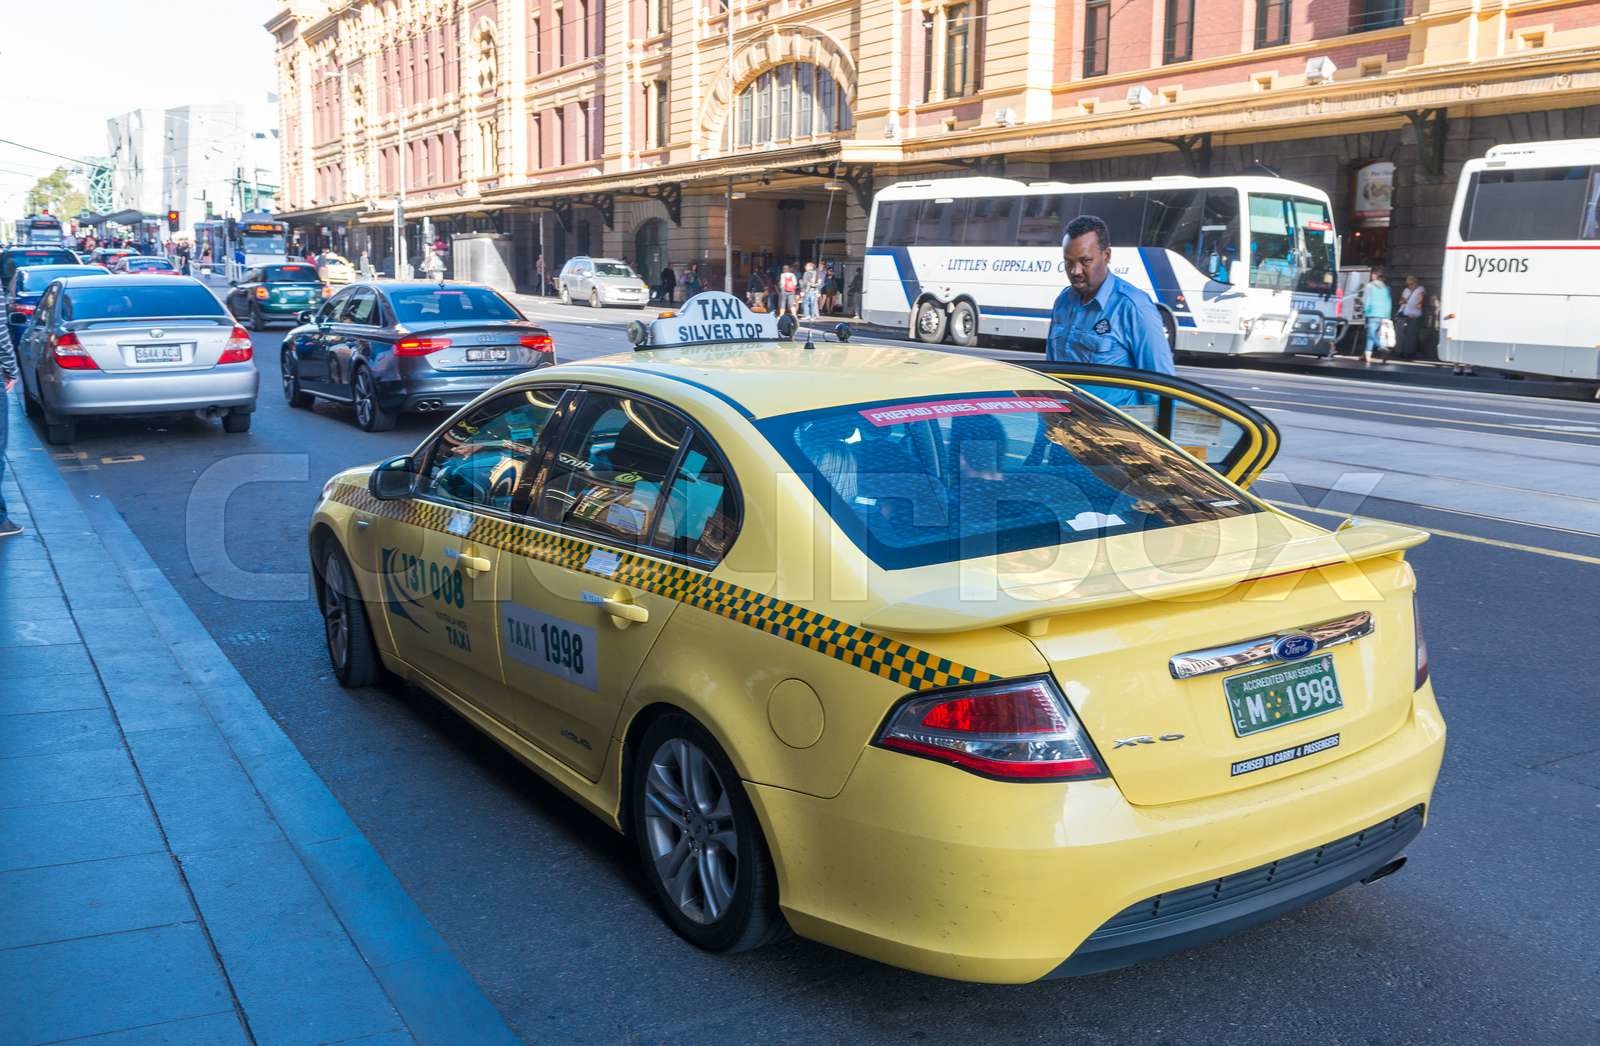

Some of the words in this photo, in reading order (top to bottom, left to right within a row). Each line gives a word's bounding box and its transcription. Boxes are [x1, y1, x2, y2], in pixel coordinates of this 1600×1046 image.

[947, 258, 988, 271] LITTLE'S
[992, 259, 1052, 272] GIPPSLAND
[1464, 253, 1529, 277] Dysons
[696, 298, 743, 320] TAXI
[678, 323, 732, 341] SILVER
[735, 323, 763, 339] TOP
[872, 408, 931, 422] PREPAID
[931, 404, 977, 414] FARES
[978, 402, 1013, 410] 10PM
[401, 553, 426, 592] 131
[430, 562, 465, 608] 008
[446, 625, 472, 653] TAXI
[507, 617, 537, 652] TAXI
[541, 623, 584, 674] 1998
[1284, 639, 1308, 656] Ford
[1243, 674, 1285, 692] ACCREDITED
[1297, 663, 1323, 679] SERVICE
[1232, 698, 1247, 728] VIC
[1246, 694, 1268, 725] M
[1286, 675, 1337, 714] 1998
[1231, 757, 1264, 774] LICENSED
[1264, 755, 1274, 766] TO
[1274, 748, 1296, 764] CARRY
[1303, 735, 1340, 755] PASSENGERS
